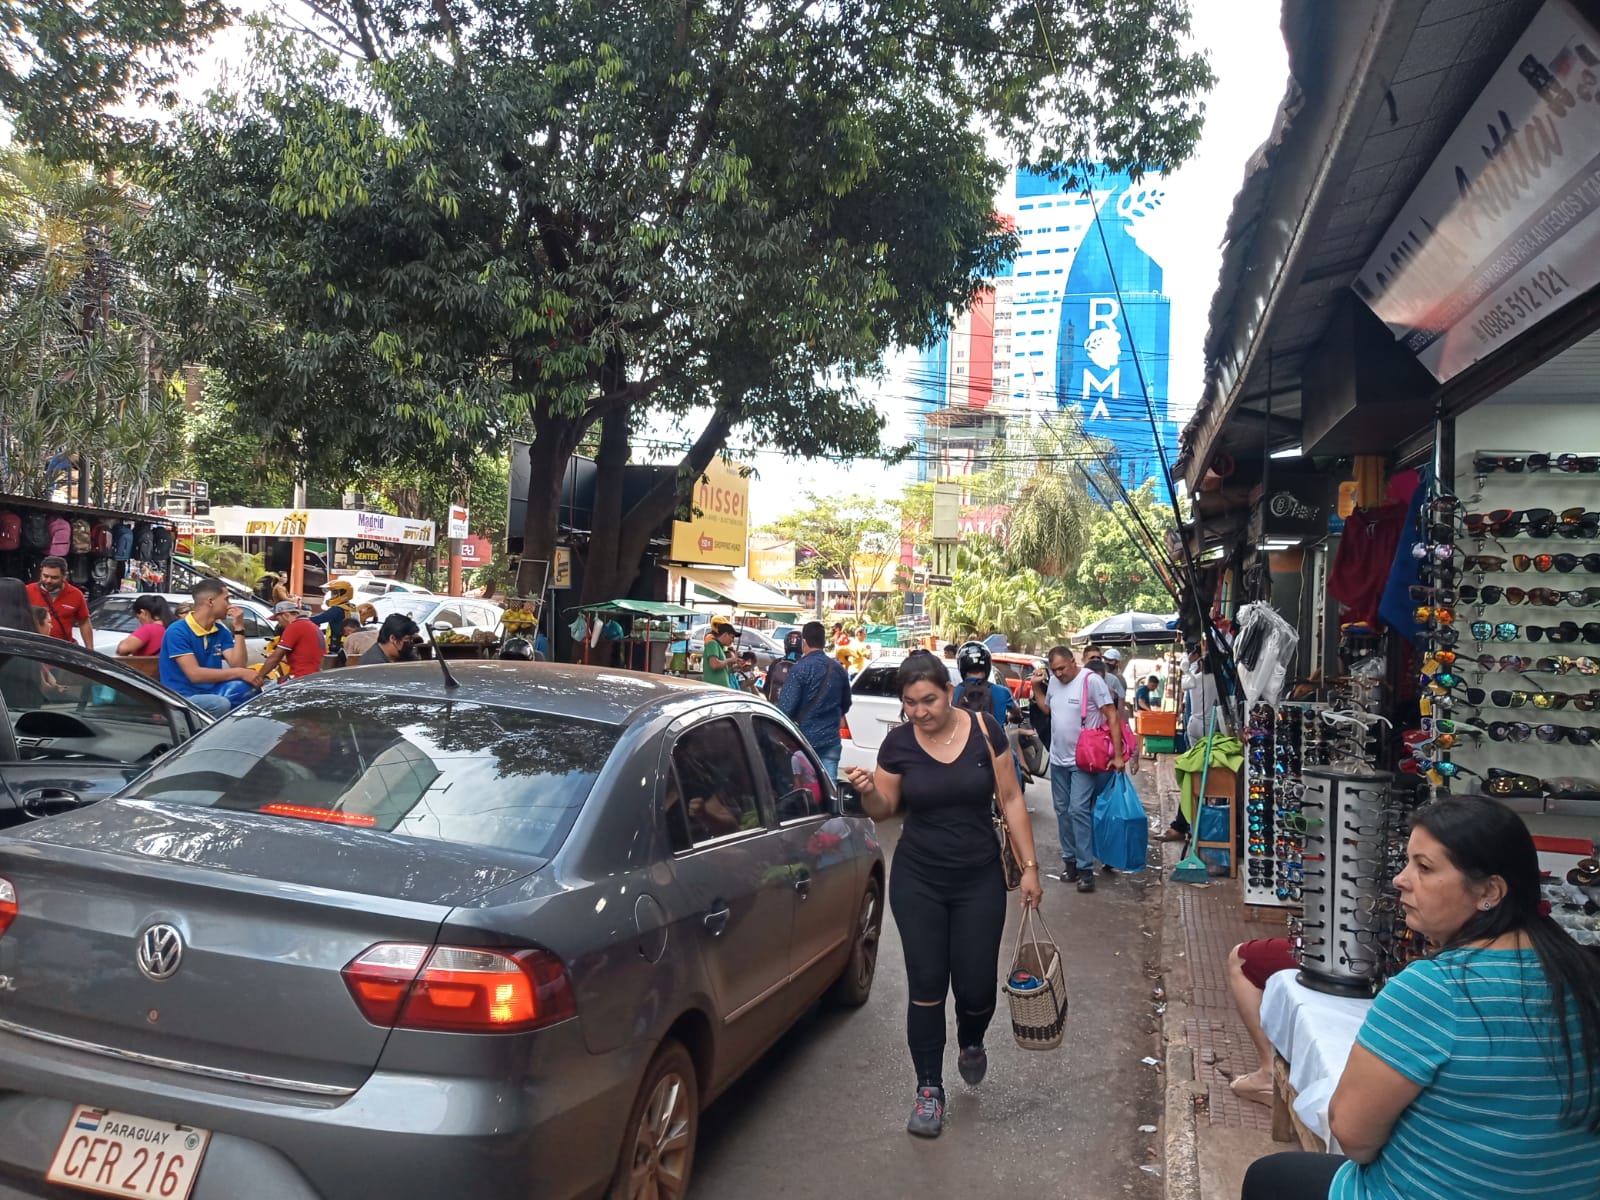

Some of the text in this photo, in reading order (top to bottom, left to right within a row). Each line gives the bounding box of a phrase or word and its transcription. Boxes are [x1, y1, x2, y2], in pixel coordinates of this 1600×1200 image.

[1511, 234, 1538, 261] PARA
[1478, 303, 1516, 339] 0985
[1505, 286, 1543, 319] 512
[1531, 264, 1571, 299] 121
[358, 513, 384, 529] Madrid
[350, 541, 384, 557] TAXI RADIO
[354, 551, 379, 561] CENTER
[103, 1121, 170, 1145] PARAGUAY
[63, 1135, 184, 1197] CFR 216
